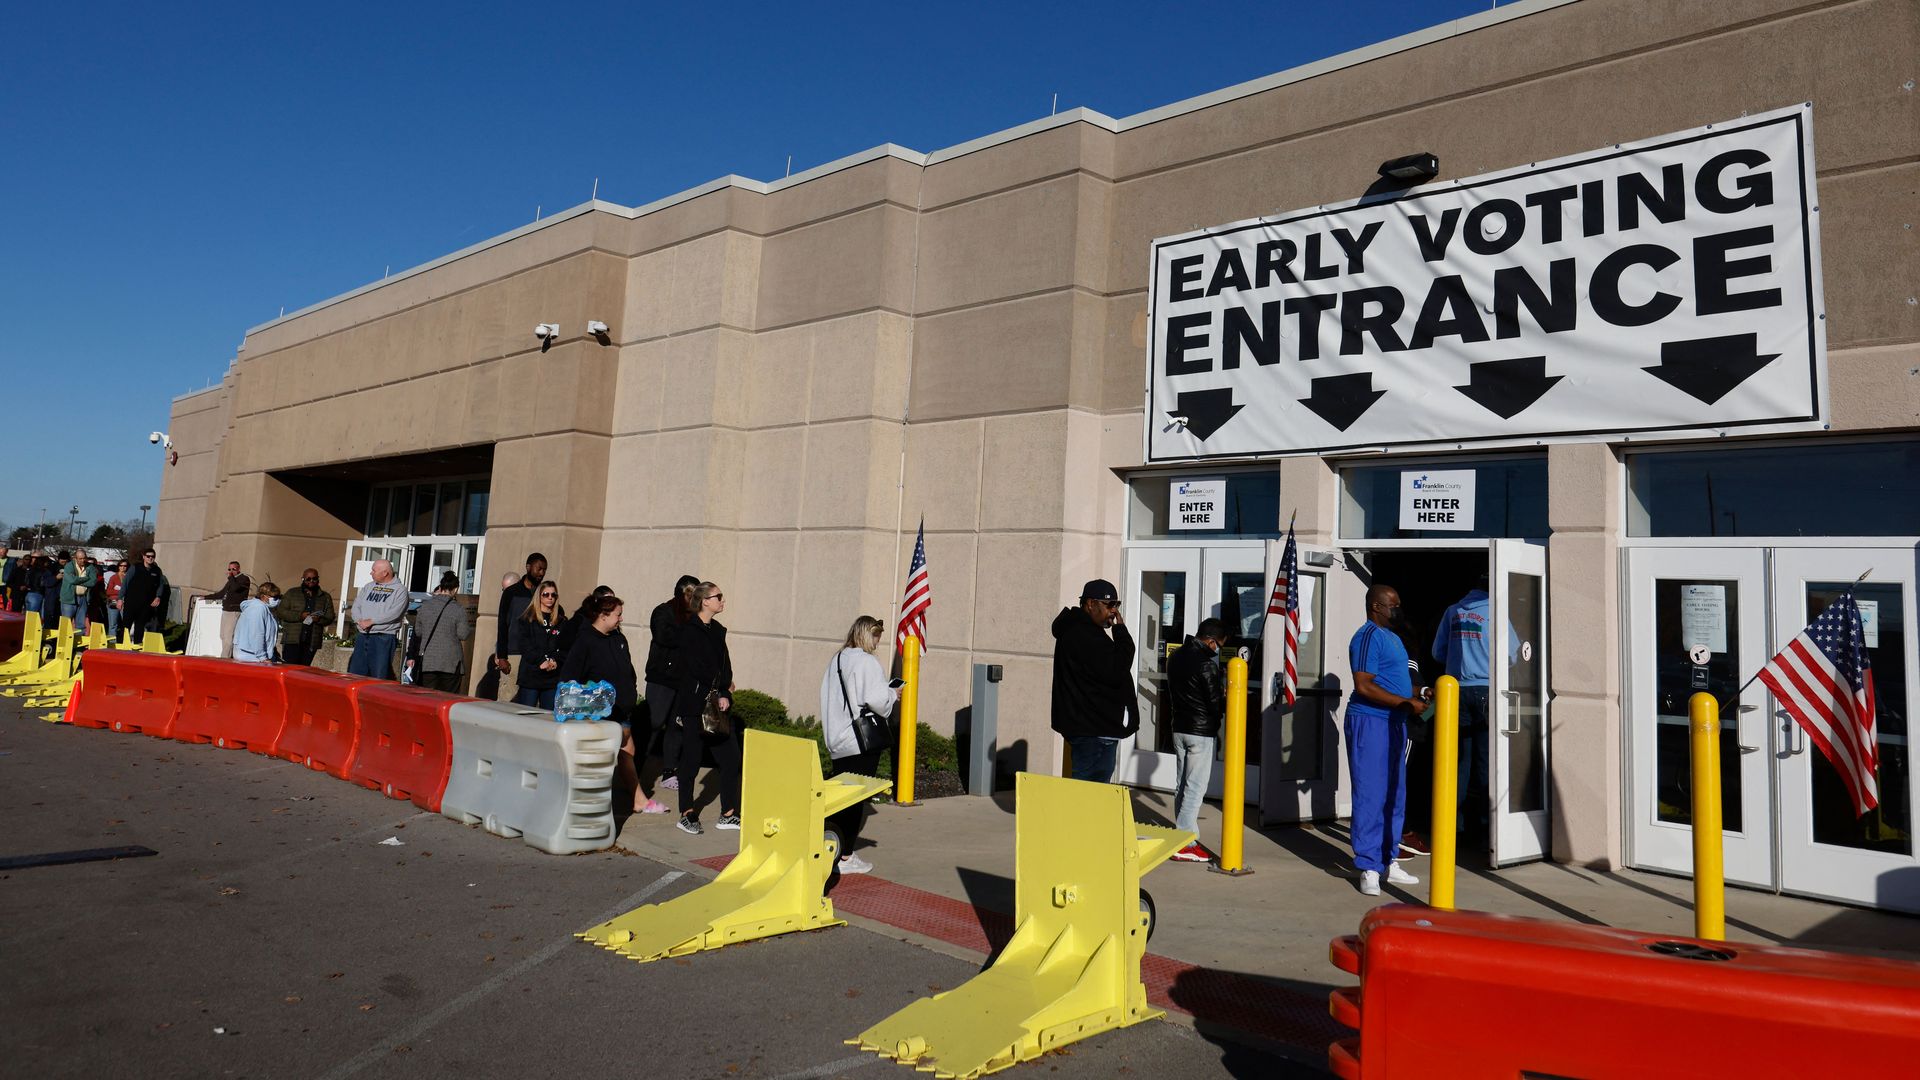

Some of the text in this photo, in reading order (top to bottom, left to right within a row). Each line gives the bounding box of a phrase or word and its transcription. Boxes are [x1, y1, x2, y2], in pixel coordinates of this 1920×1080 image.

[1169, 149, 1774, 303] EARLY VOTING
[1165, 225, 1783, 377] ENTRANCE
[1179, 502, 1214, 512] ENTER
[1413, 498, 1460, 509] ENTER
[1182, 514, 1210, 523] HERE
[1417, 512, 1455, 523] HERE
[366, 592, 391, 603] NAVY
